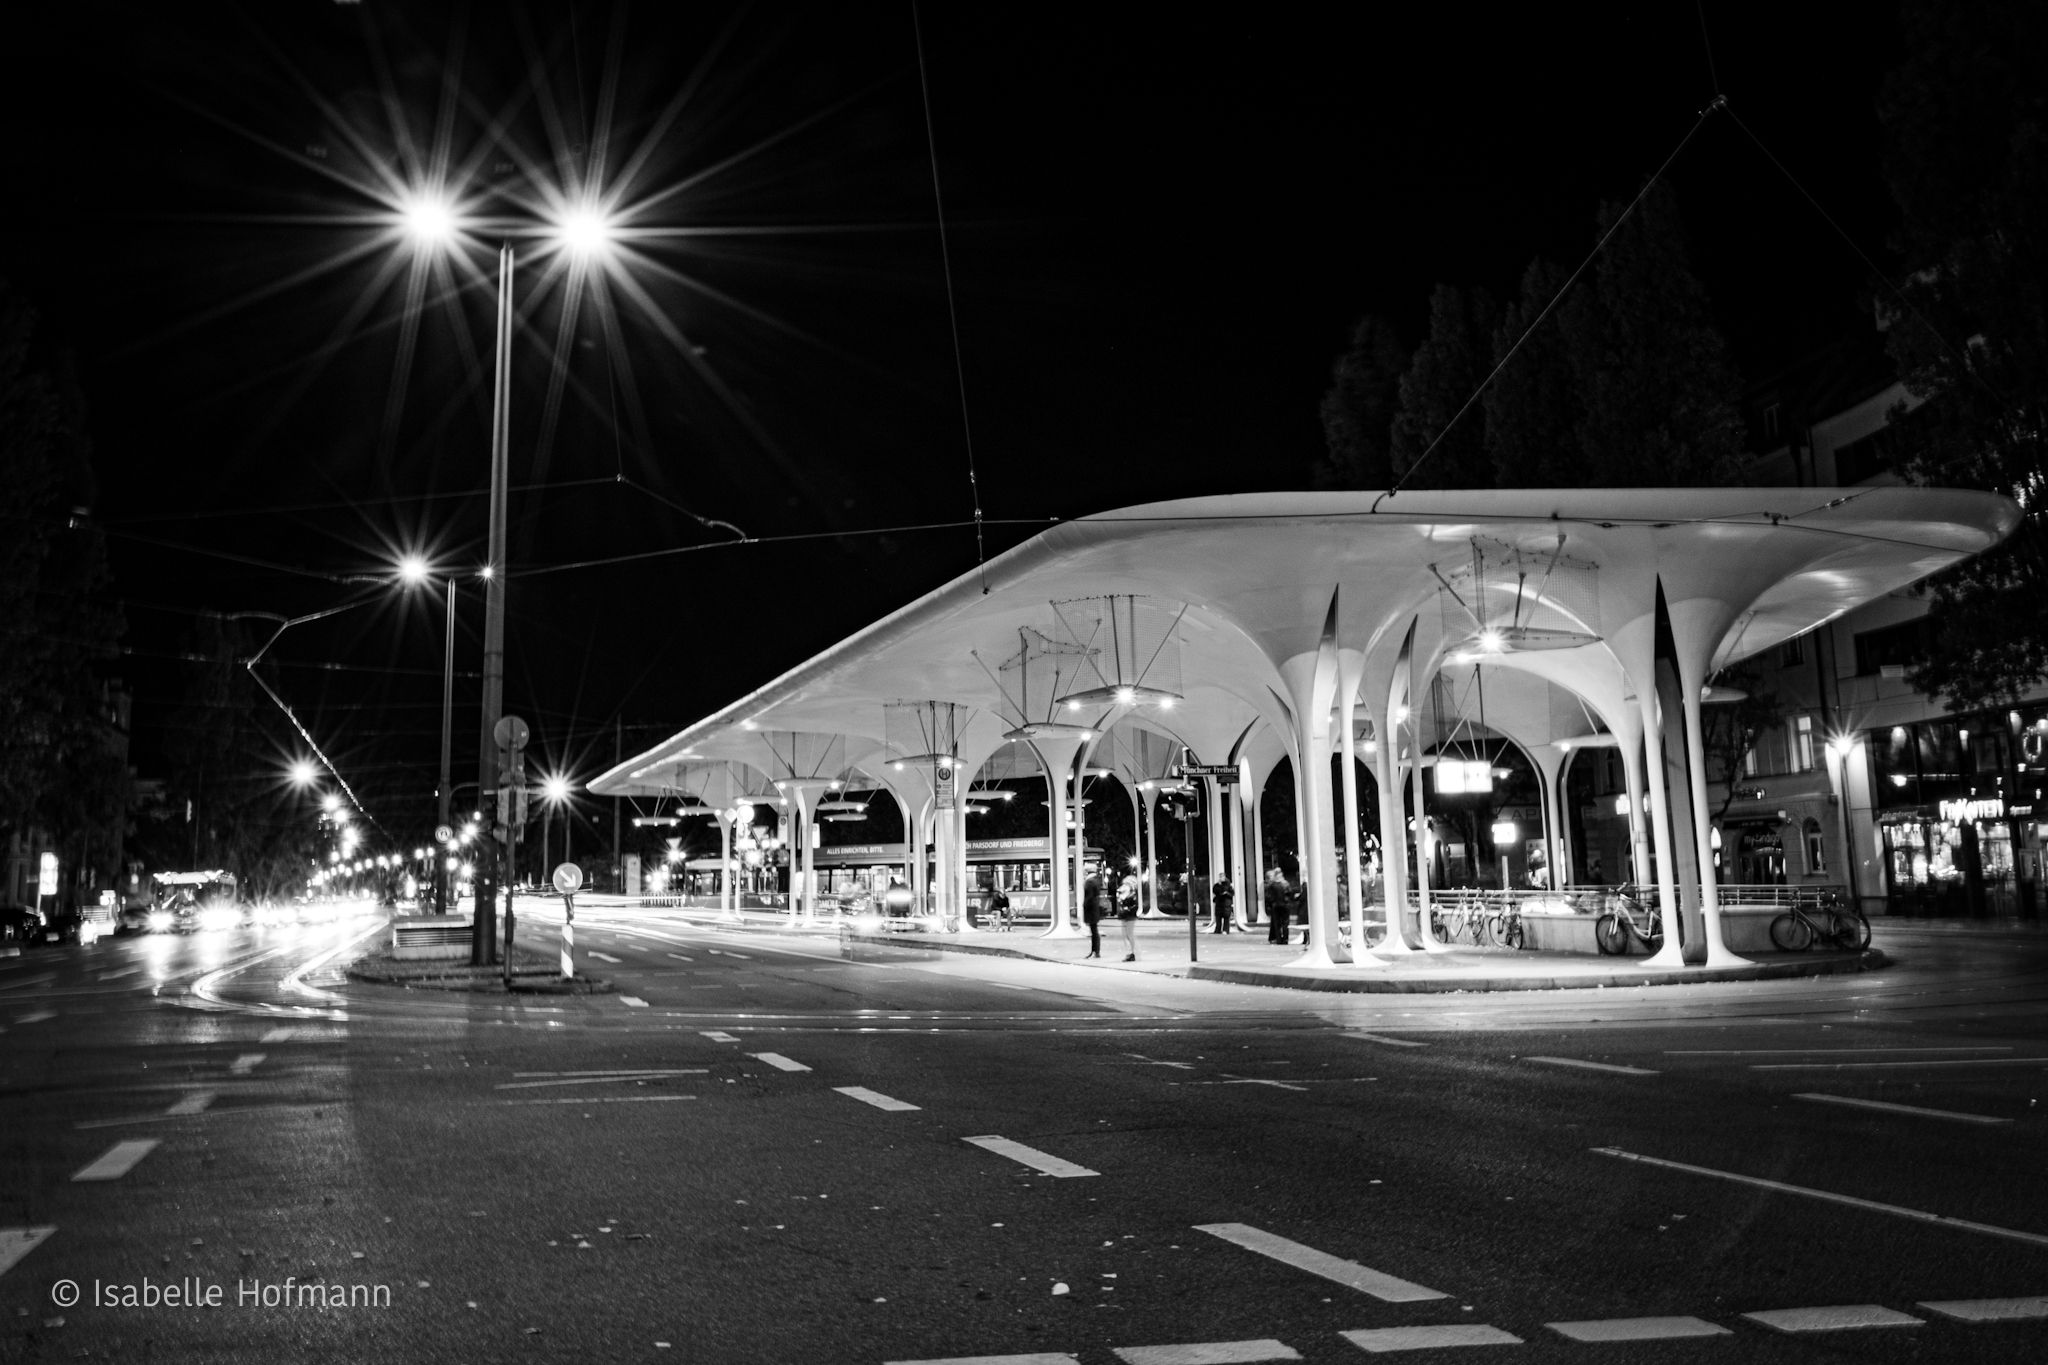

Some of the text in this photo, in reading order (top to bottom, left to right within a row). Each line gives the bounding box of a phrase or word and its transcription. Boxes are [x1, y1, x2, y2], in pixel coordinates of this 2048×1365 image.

[1180, 766, 1237, 774] Münchner Freiheit
[826, 847, 840, 855] ALLES
[972, 841, 999, 849] PARSDORF
[1000, 840, 1012, 849] UND
